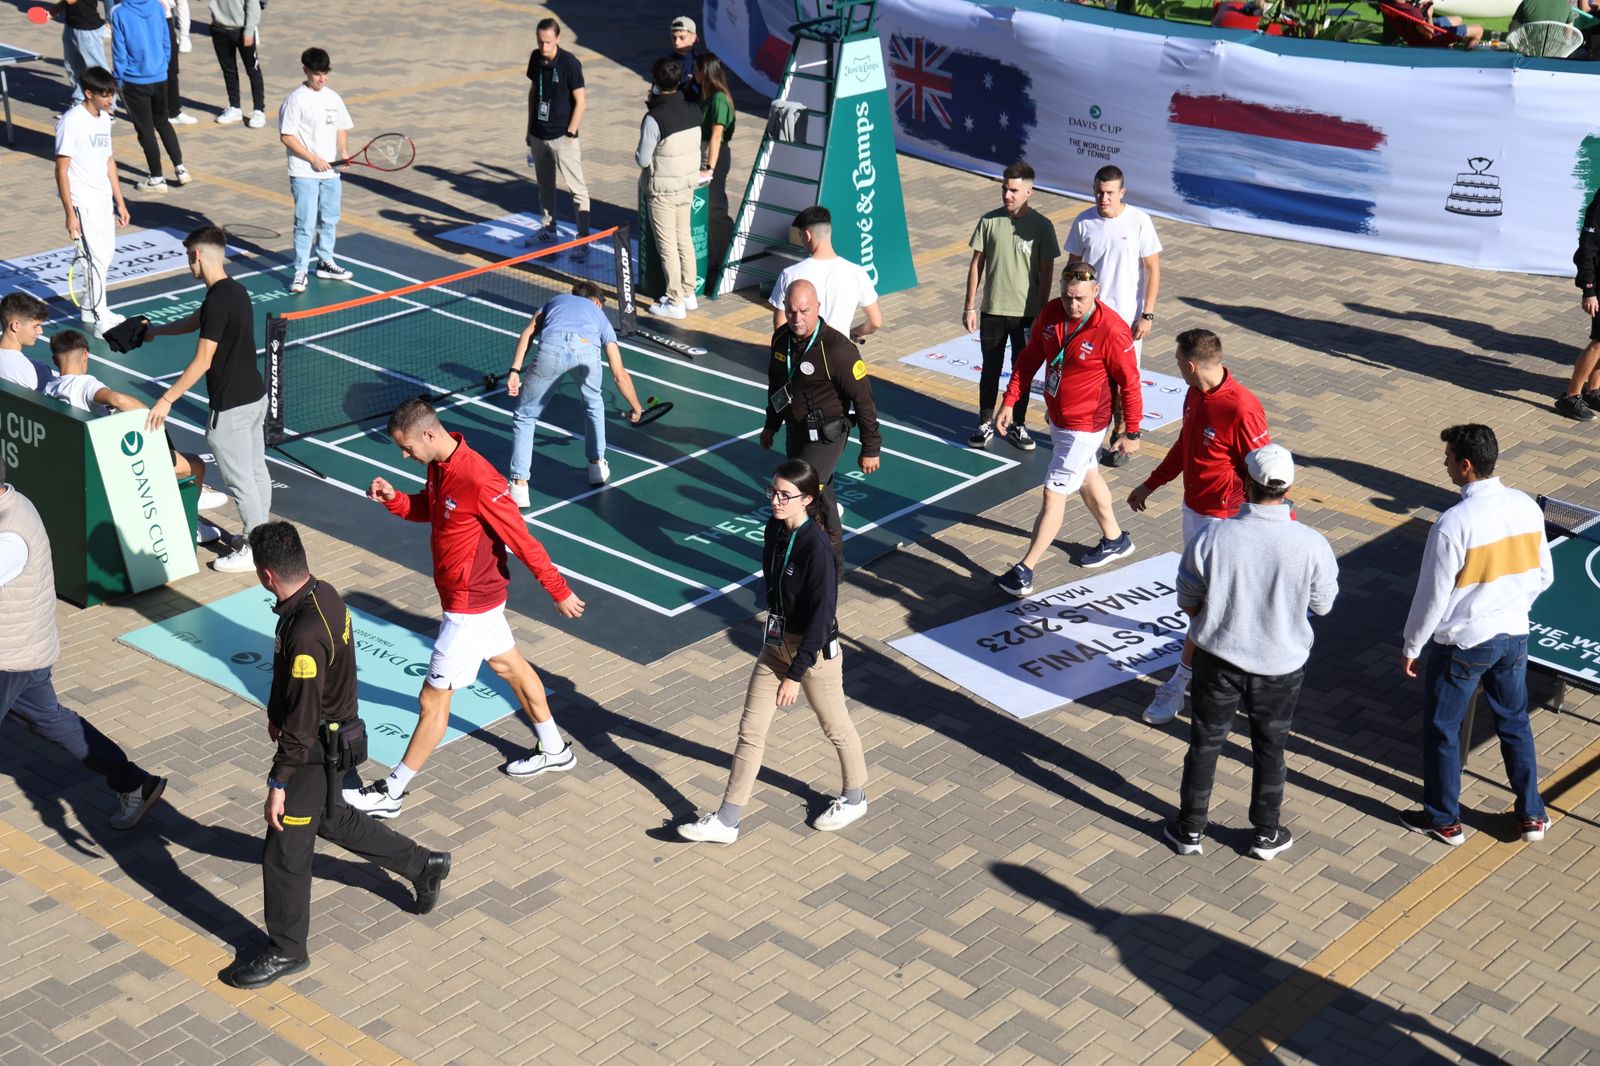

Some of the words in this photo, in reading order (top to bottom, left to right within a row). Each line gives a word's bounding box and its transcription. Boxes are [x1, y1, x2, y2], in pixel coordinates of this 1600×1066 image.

[1068, 116, 1098, 131] DAVIS
[1099, 123, 1122, 135] CUP
[852, 100, 876, 190] Camps
[1069, 138, 1082, 147] THE
[1082, 141, 1106, 152] WORLD
[1106, 145, 1120, 155] CUP
[1076, 147, 1085, 156] OF
[1087, 149, 1111, 161] TENNIS
[856, 188, 876, 215] &
[119, 249, 184, 269] 2023
[621, 247, 633, 303] DUNLOP
[271, 352, 279, 419] DUNLOP
[6, 412, 46, 448] CUP
[131, 460, 158, 521] DAVIS
[148, 523, 170, 565] CUP
[684, 520, 746, 545] THE
[1006, 585, 1094, 617] MALAGA
[1057, 581, 1177, 626] FINALS
[975, 616, 1064, 653] 2023
[1537, 637, 1577, 651] OF
[356, 639, 409, 666] DAVIS
[1017, 629, 1146, 678] FINALS
[373, 724, 400, 736] ITF
